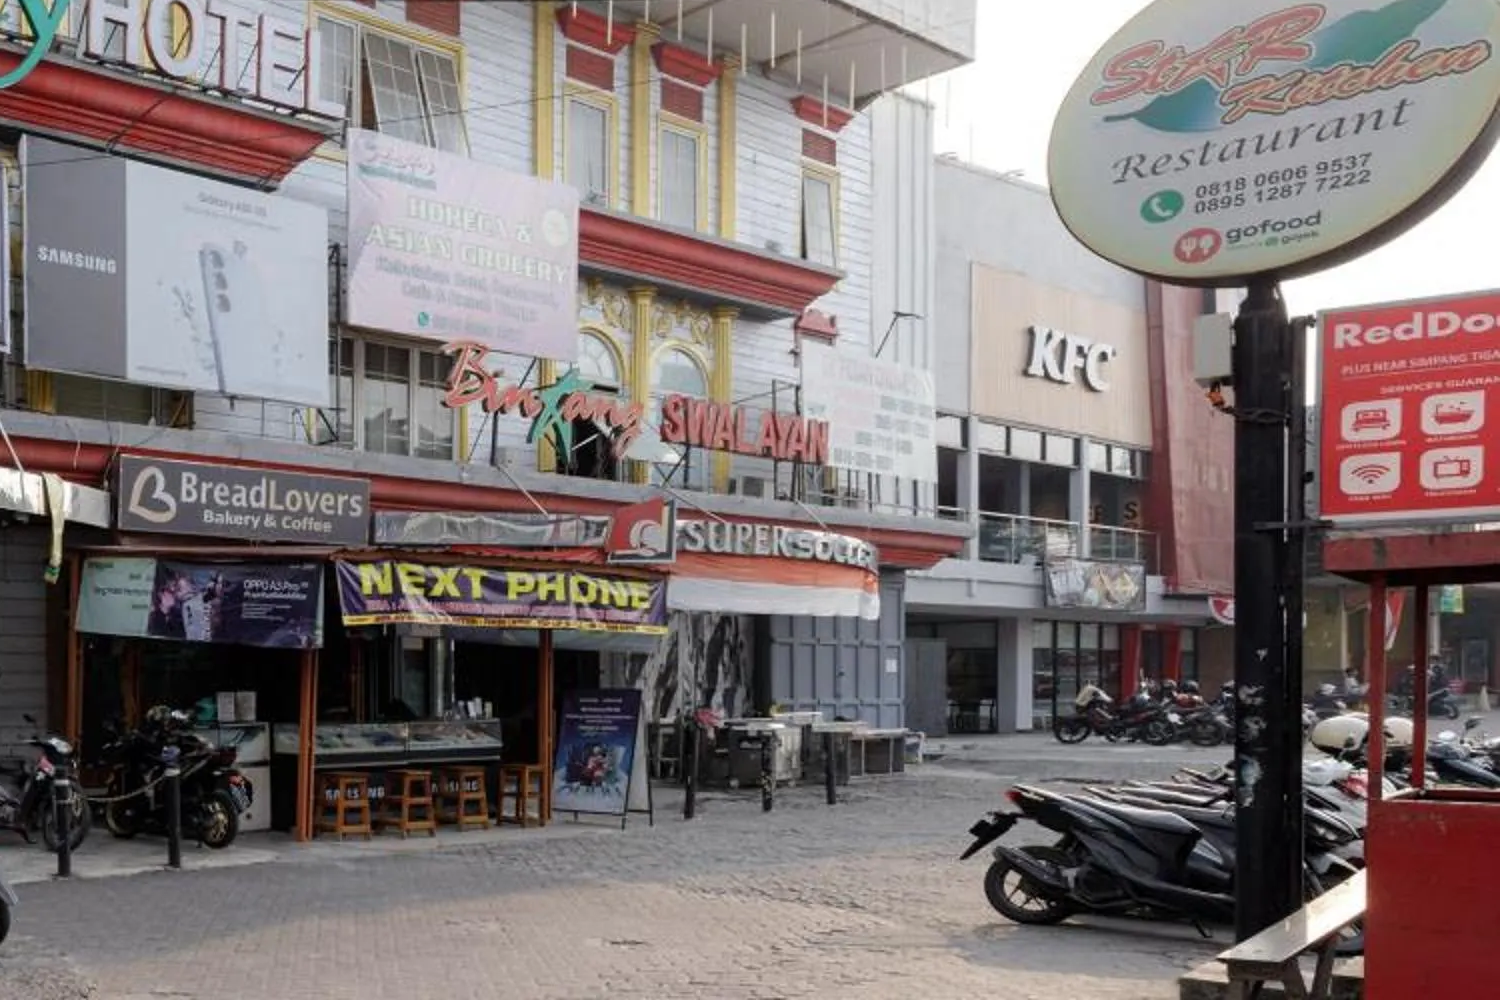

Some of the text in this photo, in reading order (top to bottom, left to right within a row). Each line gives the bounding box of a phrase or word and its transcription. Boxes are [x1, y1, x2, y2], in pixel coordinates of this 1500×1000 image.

[1220, 39, 1492, 126] Kitchen
[1112, 97, 1414, 185] Restaurant
[1194, 169, 1372, 215] 0895 1287 7222
[1195, 152, 1373, 200] 0818 0606 9537
[515, 222, 534, 246] &
[1226, 210, 1323, 244] gofood
[37, 246, 117, 275] SAMSUNG
[1333, 311, 1500, 349] RedDo
[1023, 325, 1115, 392] KFC
[660, 393, 831, 466] SWALAYAN
[180, 471, 363, 518] BreadLovers
[202, 508, 333, 533] Bakery & Coffee
[357, 561, 652, 610] NEXT PHONE
